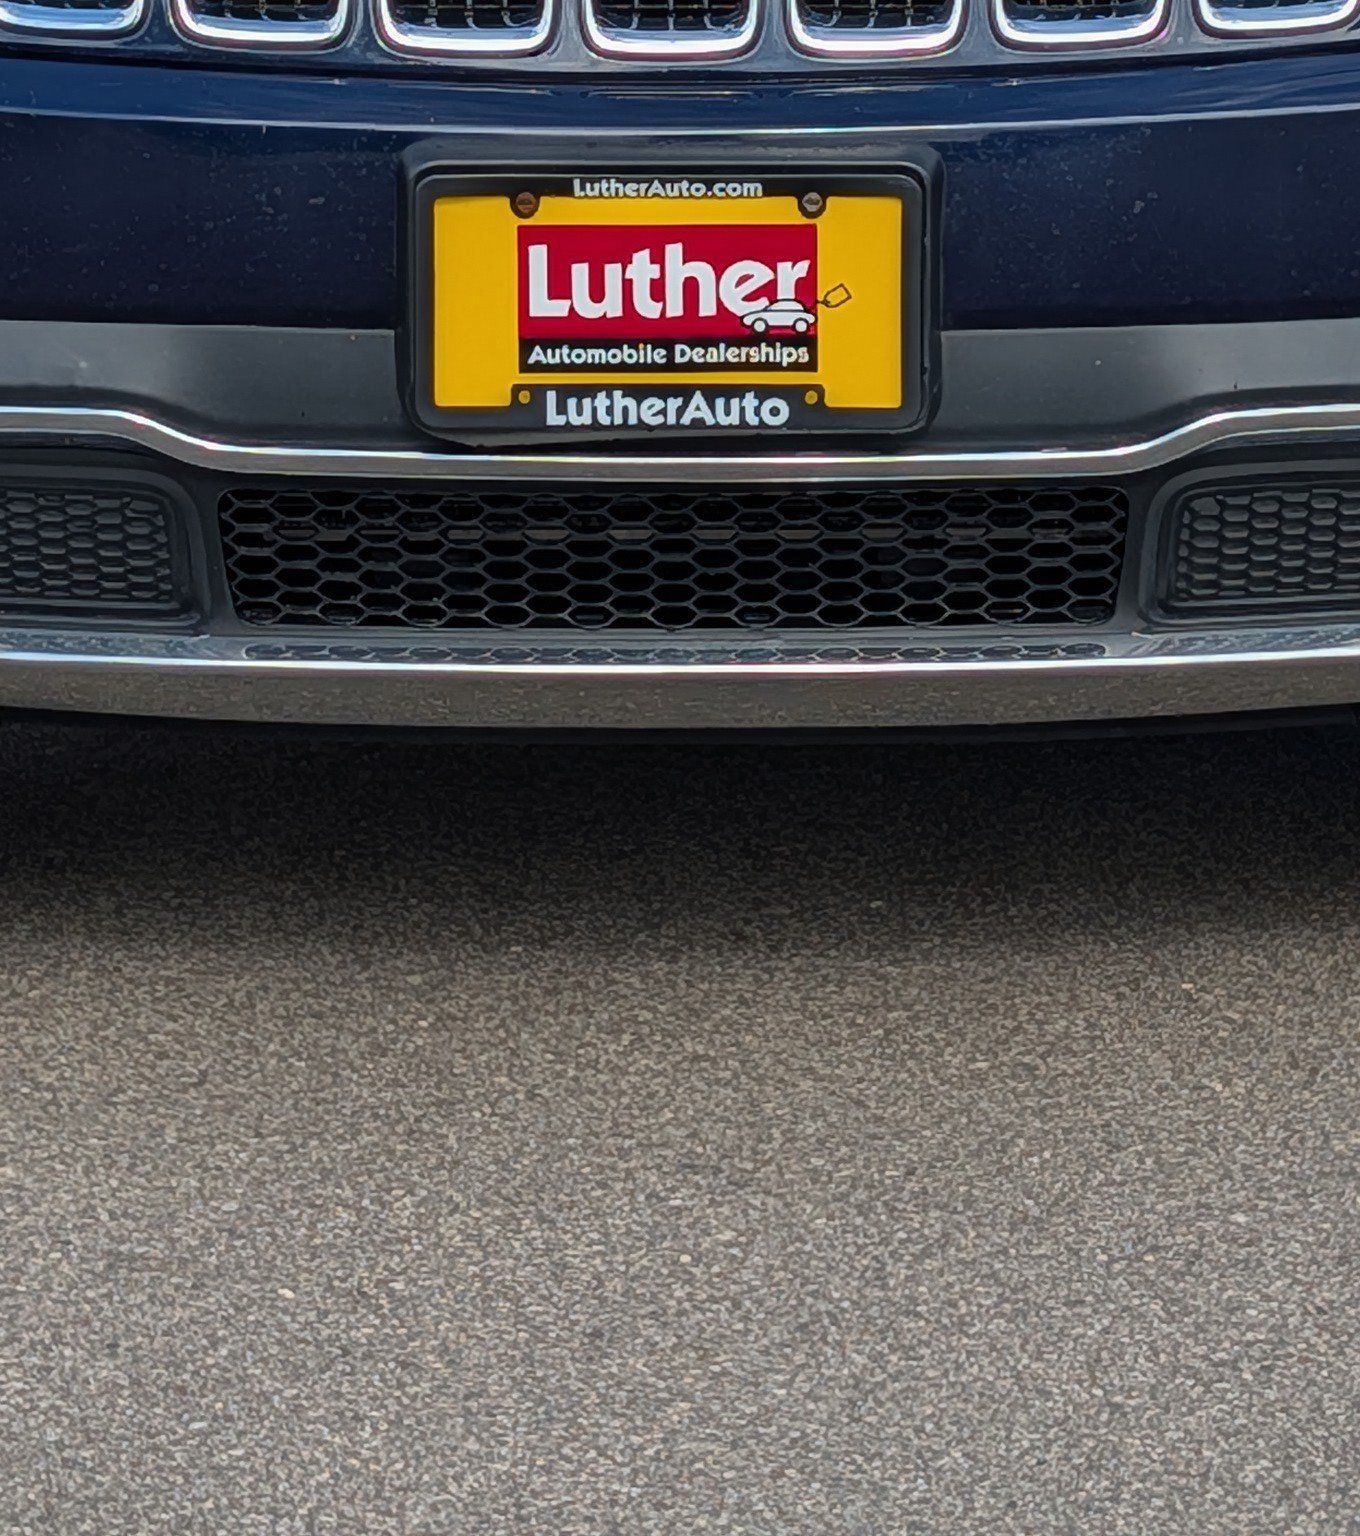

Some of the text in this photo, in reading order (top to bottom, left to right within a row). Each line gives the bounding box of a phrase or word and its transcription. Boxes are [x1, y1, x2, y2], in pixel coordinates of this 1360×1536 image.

[572, 177, 763, 198] LutherAuto.com
[526, 242, 811, 319] Luther
[527, 342, 810, 367] Automobile Dealerships
[545, 389, 790, 426] LutherAuto
